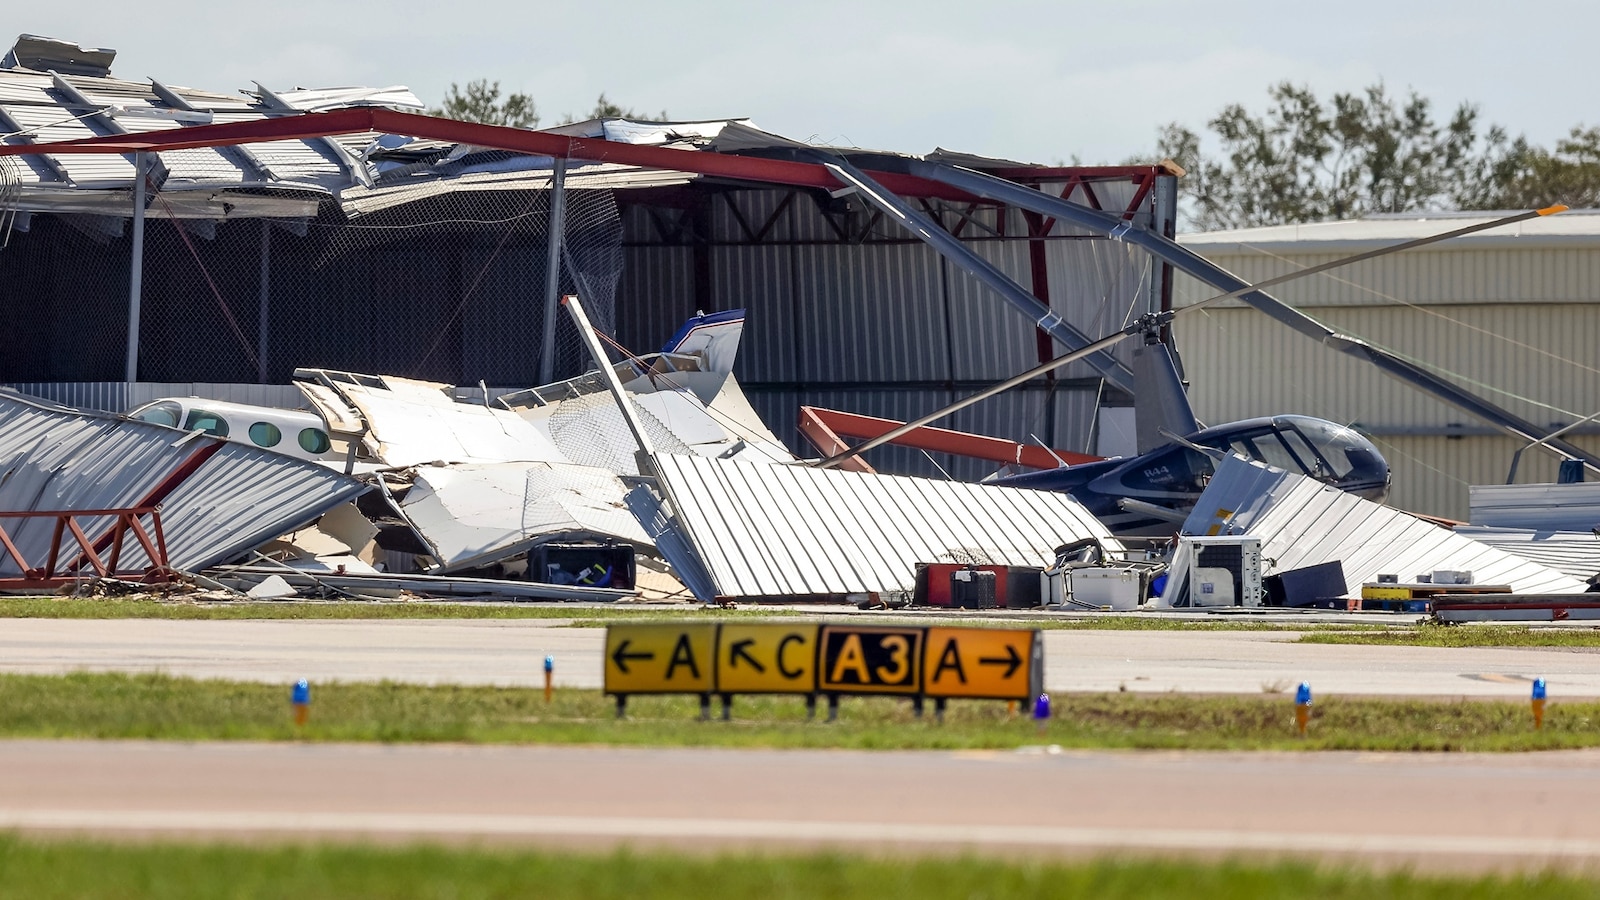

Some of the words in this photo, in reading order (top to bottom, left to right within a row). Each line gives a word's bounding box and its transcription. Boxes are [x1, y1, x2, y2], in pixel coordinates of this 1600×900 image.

[1143, 465, 1169, 477] R44
[665, 634, 700, 679] A
[777, 634, 805, 678] C
[831, 633, 910, 684] A3
[933, 638, 967, 683] A
